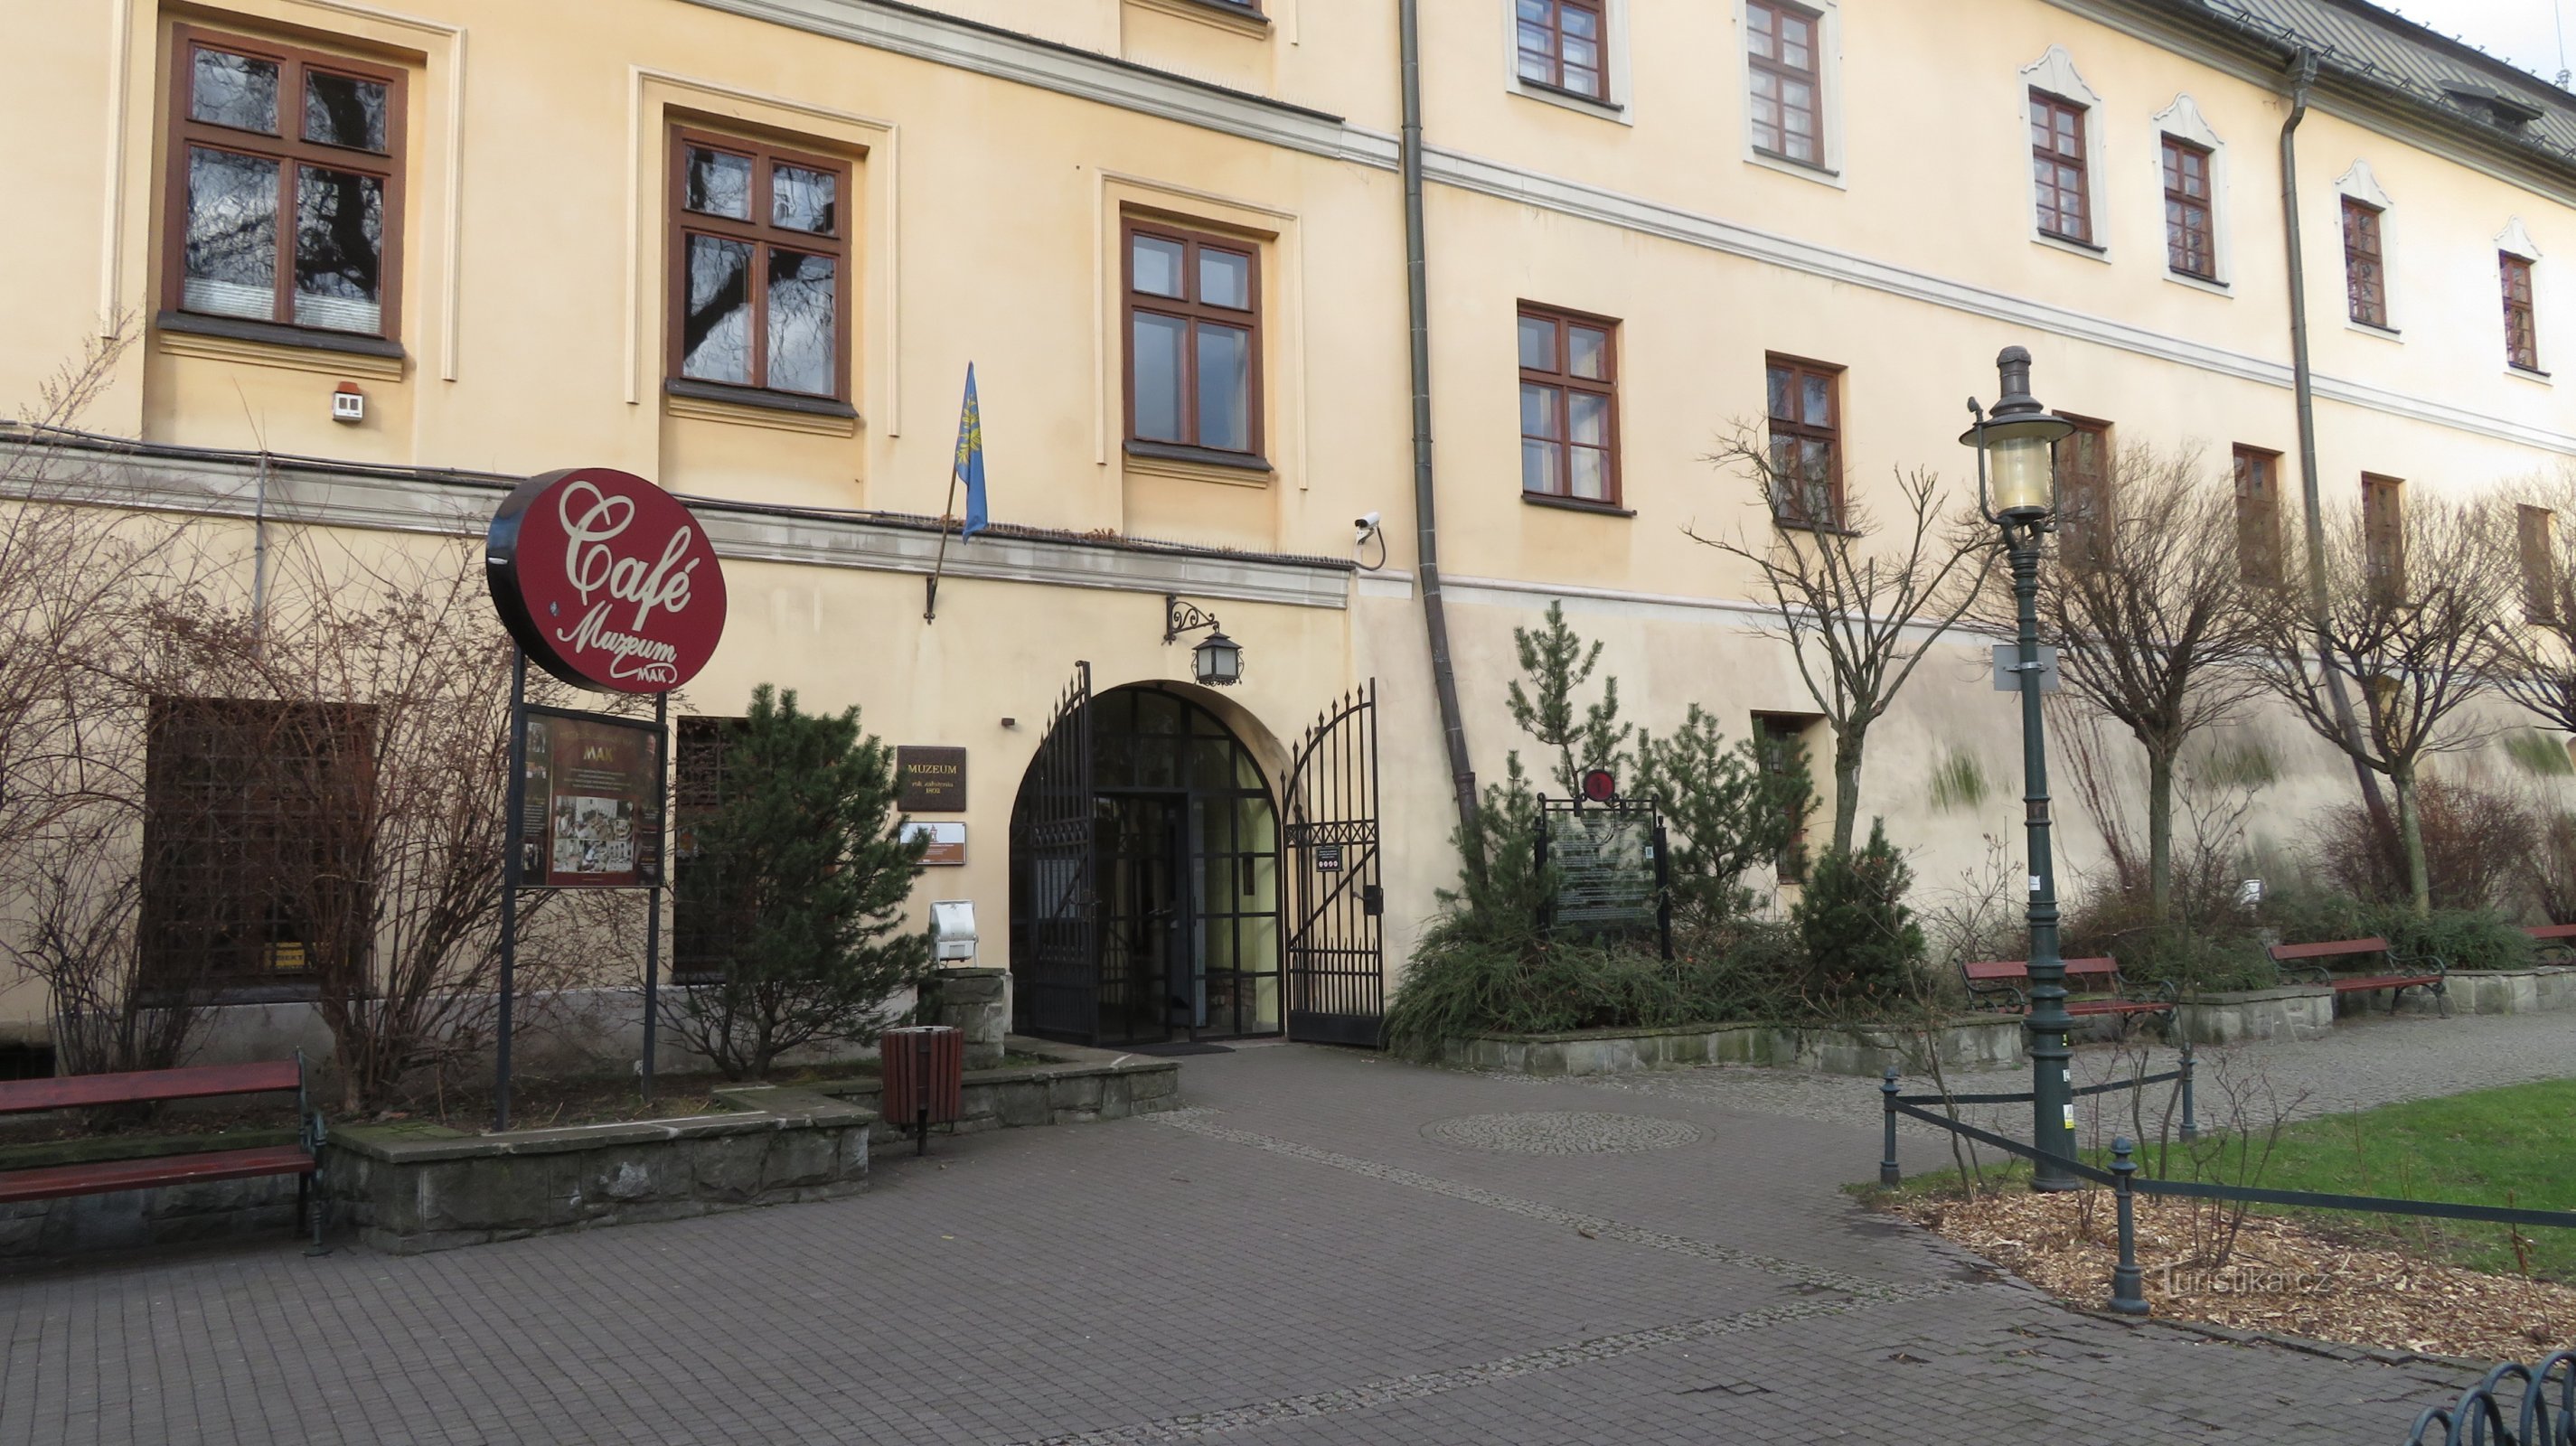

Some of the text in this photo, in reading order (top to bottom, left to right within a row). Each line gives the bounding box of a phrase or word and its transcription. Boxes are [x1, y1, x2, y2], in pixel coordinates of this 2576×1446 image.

[559, 481, 700, 631] Café
[557, 600, 677, 679] Muzeum
[636, 667, 667, 683] MAK
[584, 746, 614, 762] MAK
[907, 765, 956, 774] MUZEUM
